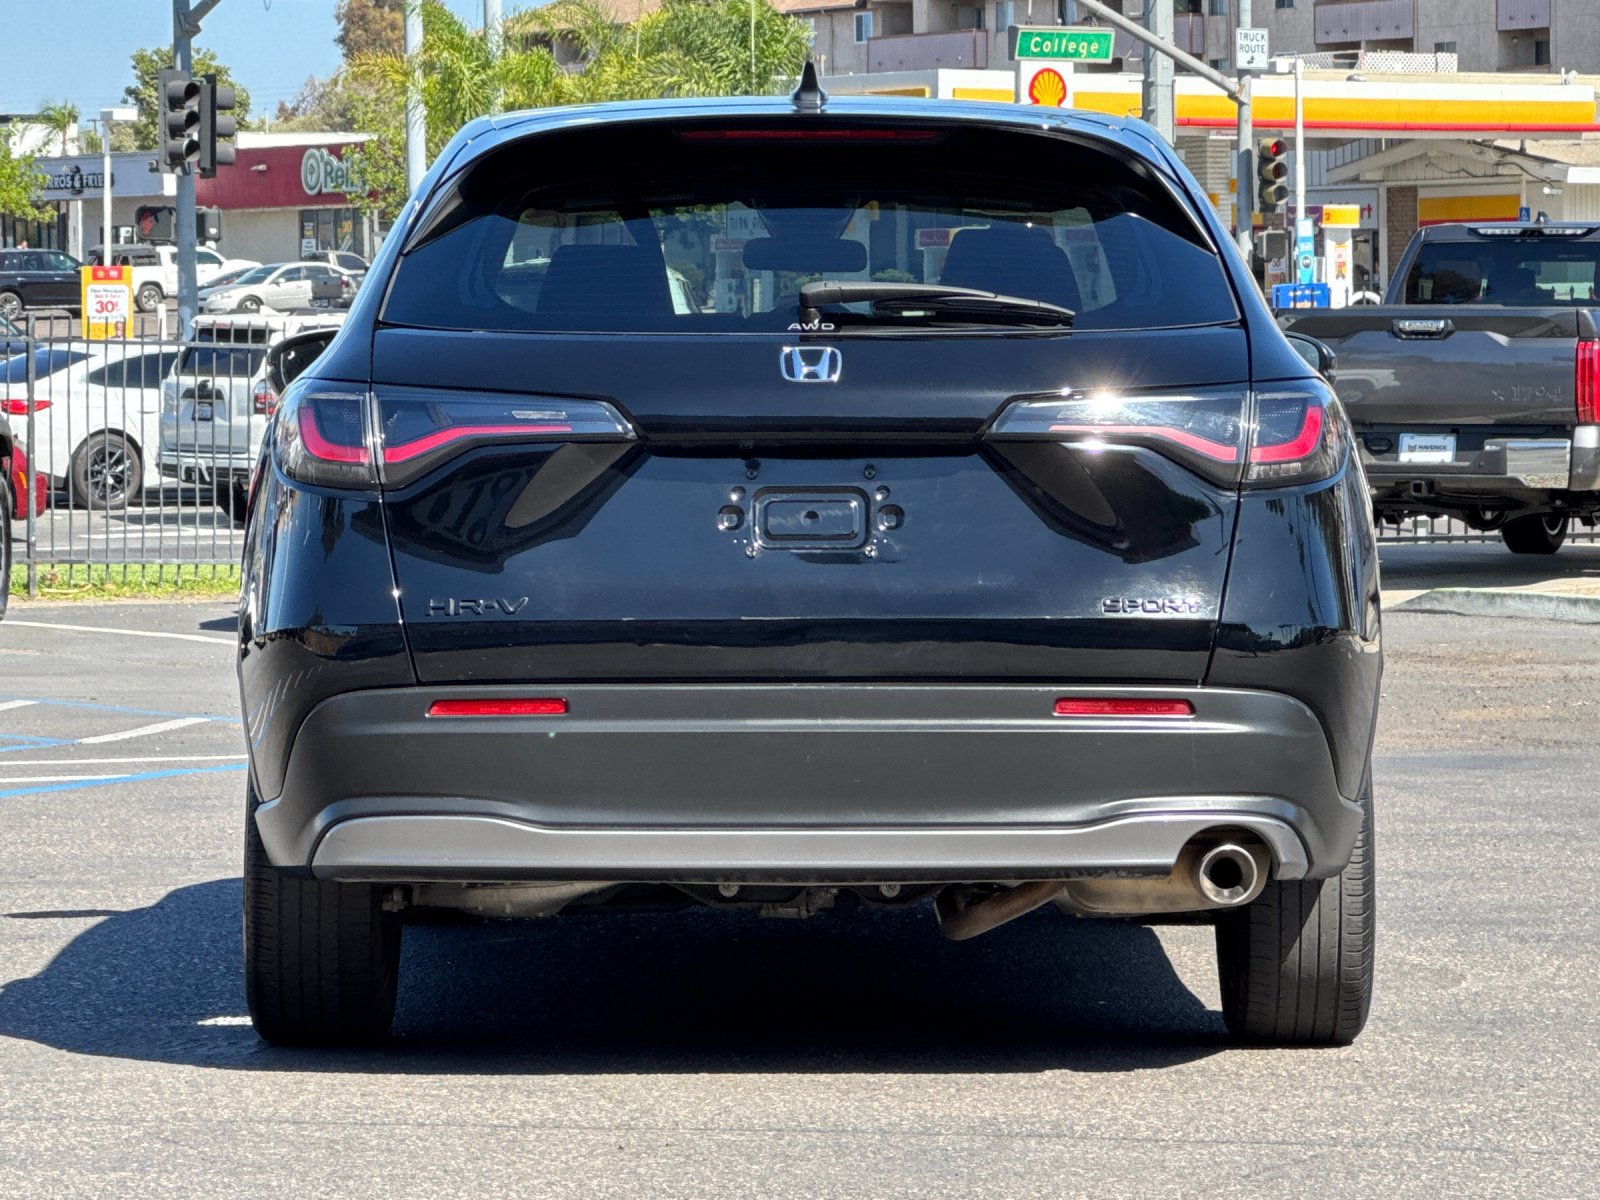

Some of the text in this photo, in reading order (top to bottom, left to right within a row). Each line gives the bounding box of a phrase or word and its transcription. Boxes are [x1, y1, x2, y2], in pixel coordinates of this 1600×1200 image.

[1239, 32, 1266, 42] TRUCK
[1030, 36, 1099, 58] College
[1239, 43, 1266, 54] ROUTE
[83, 173, 114, 188] FRIE
[1324, 212, 1331, 221] 2
[787, 323, 835, 331] AWD
[425, 597, 529, 616] HR-V
[1101, 598, 1199, 614] SPORT
